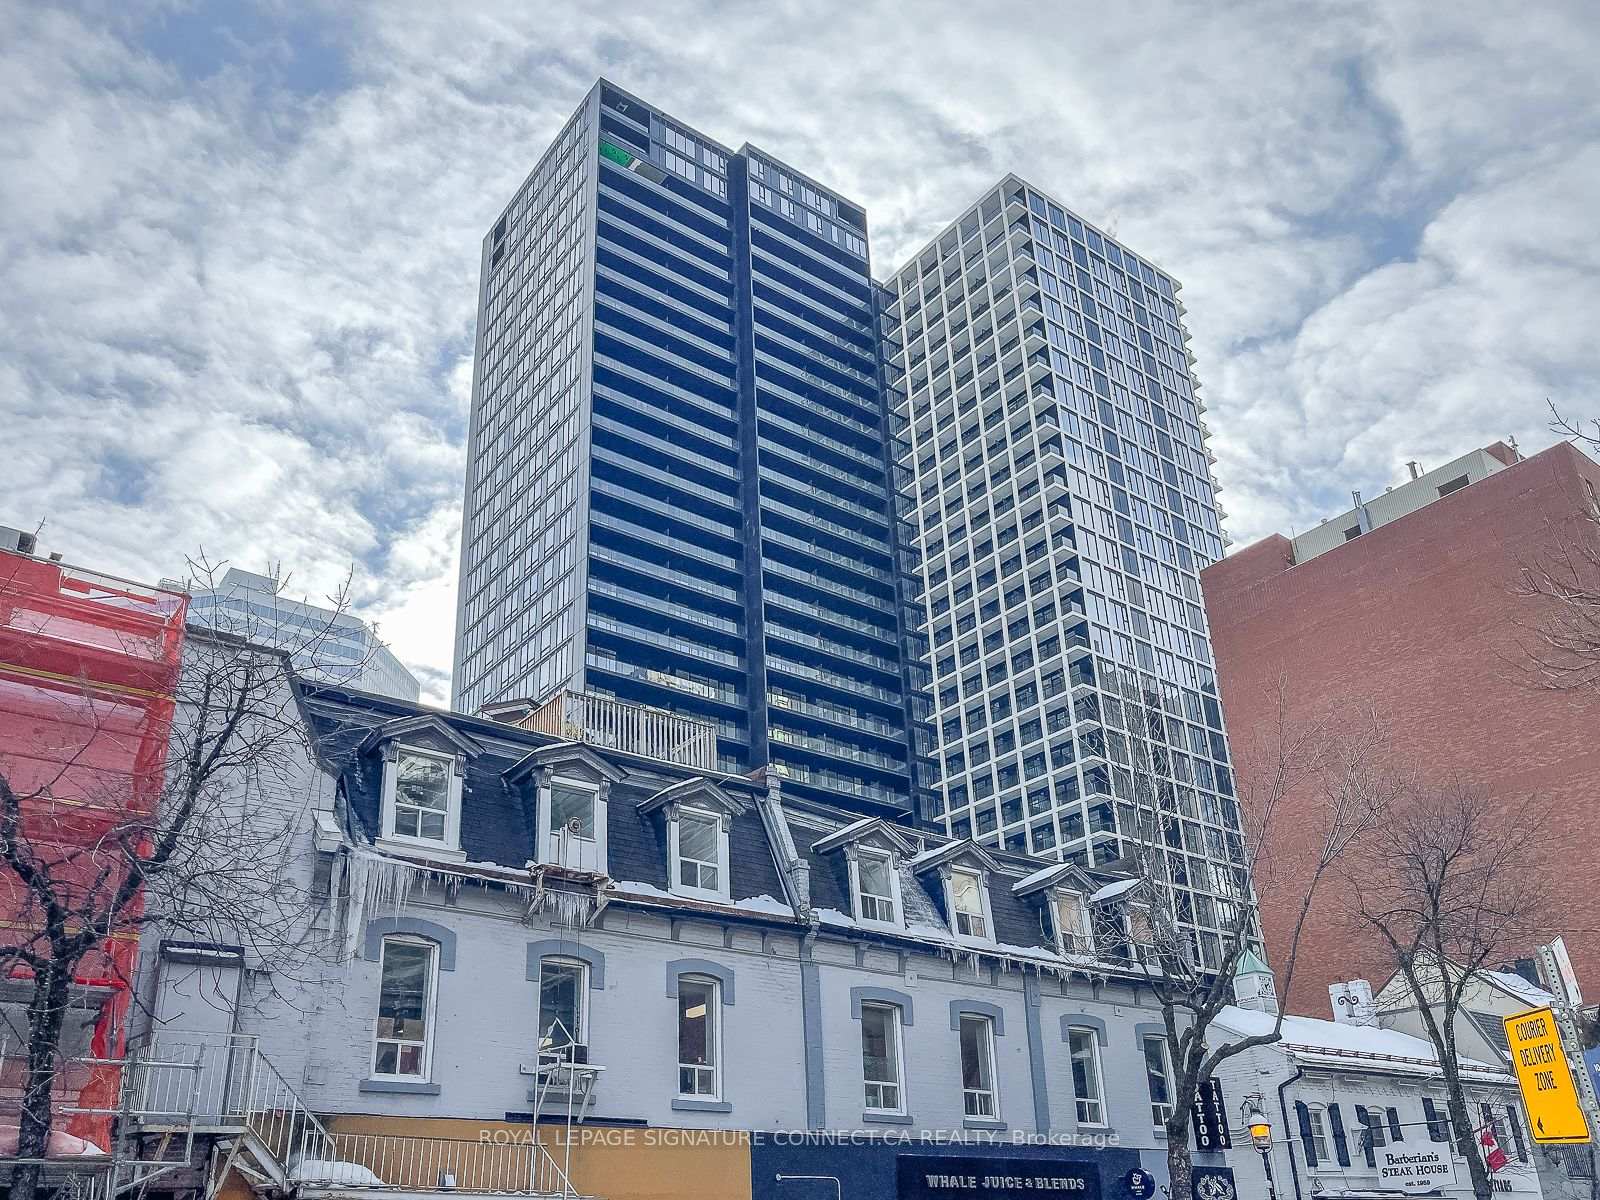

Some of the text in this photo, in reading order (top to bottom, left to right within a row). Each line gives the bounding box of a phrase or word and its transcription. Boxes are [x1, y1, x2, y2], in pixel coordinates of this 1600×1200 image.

[1515, 1018, 1549, 1042] COURIER
[1519, 1043, 1557, 1067] DELIVERY
[1534, 1070, 1558, 1091] ZONE
[1209, 1080, 1226, 1146] TATTOO
[1385, 1151, 1440, 1166] Barberian's
[1381, 1164, 1449, 1178] STEAK HOUSE
[925, 1174, 977, 1189] WHALE
[981, 1175, 1023, 1189] JUICE
[1034, 1177, 1086, 1190] BLENDS
